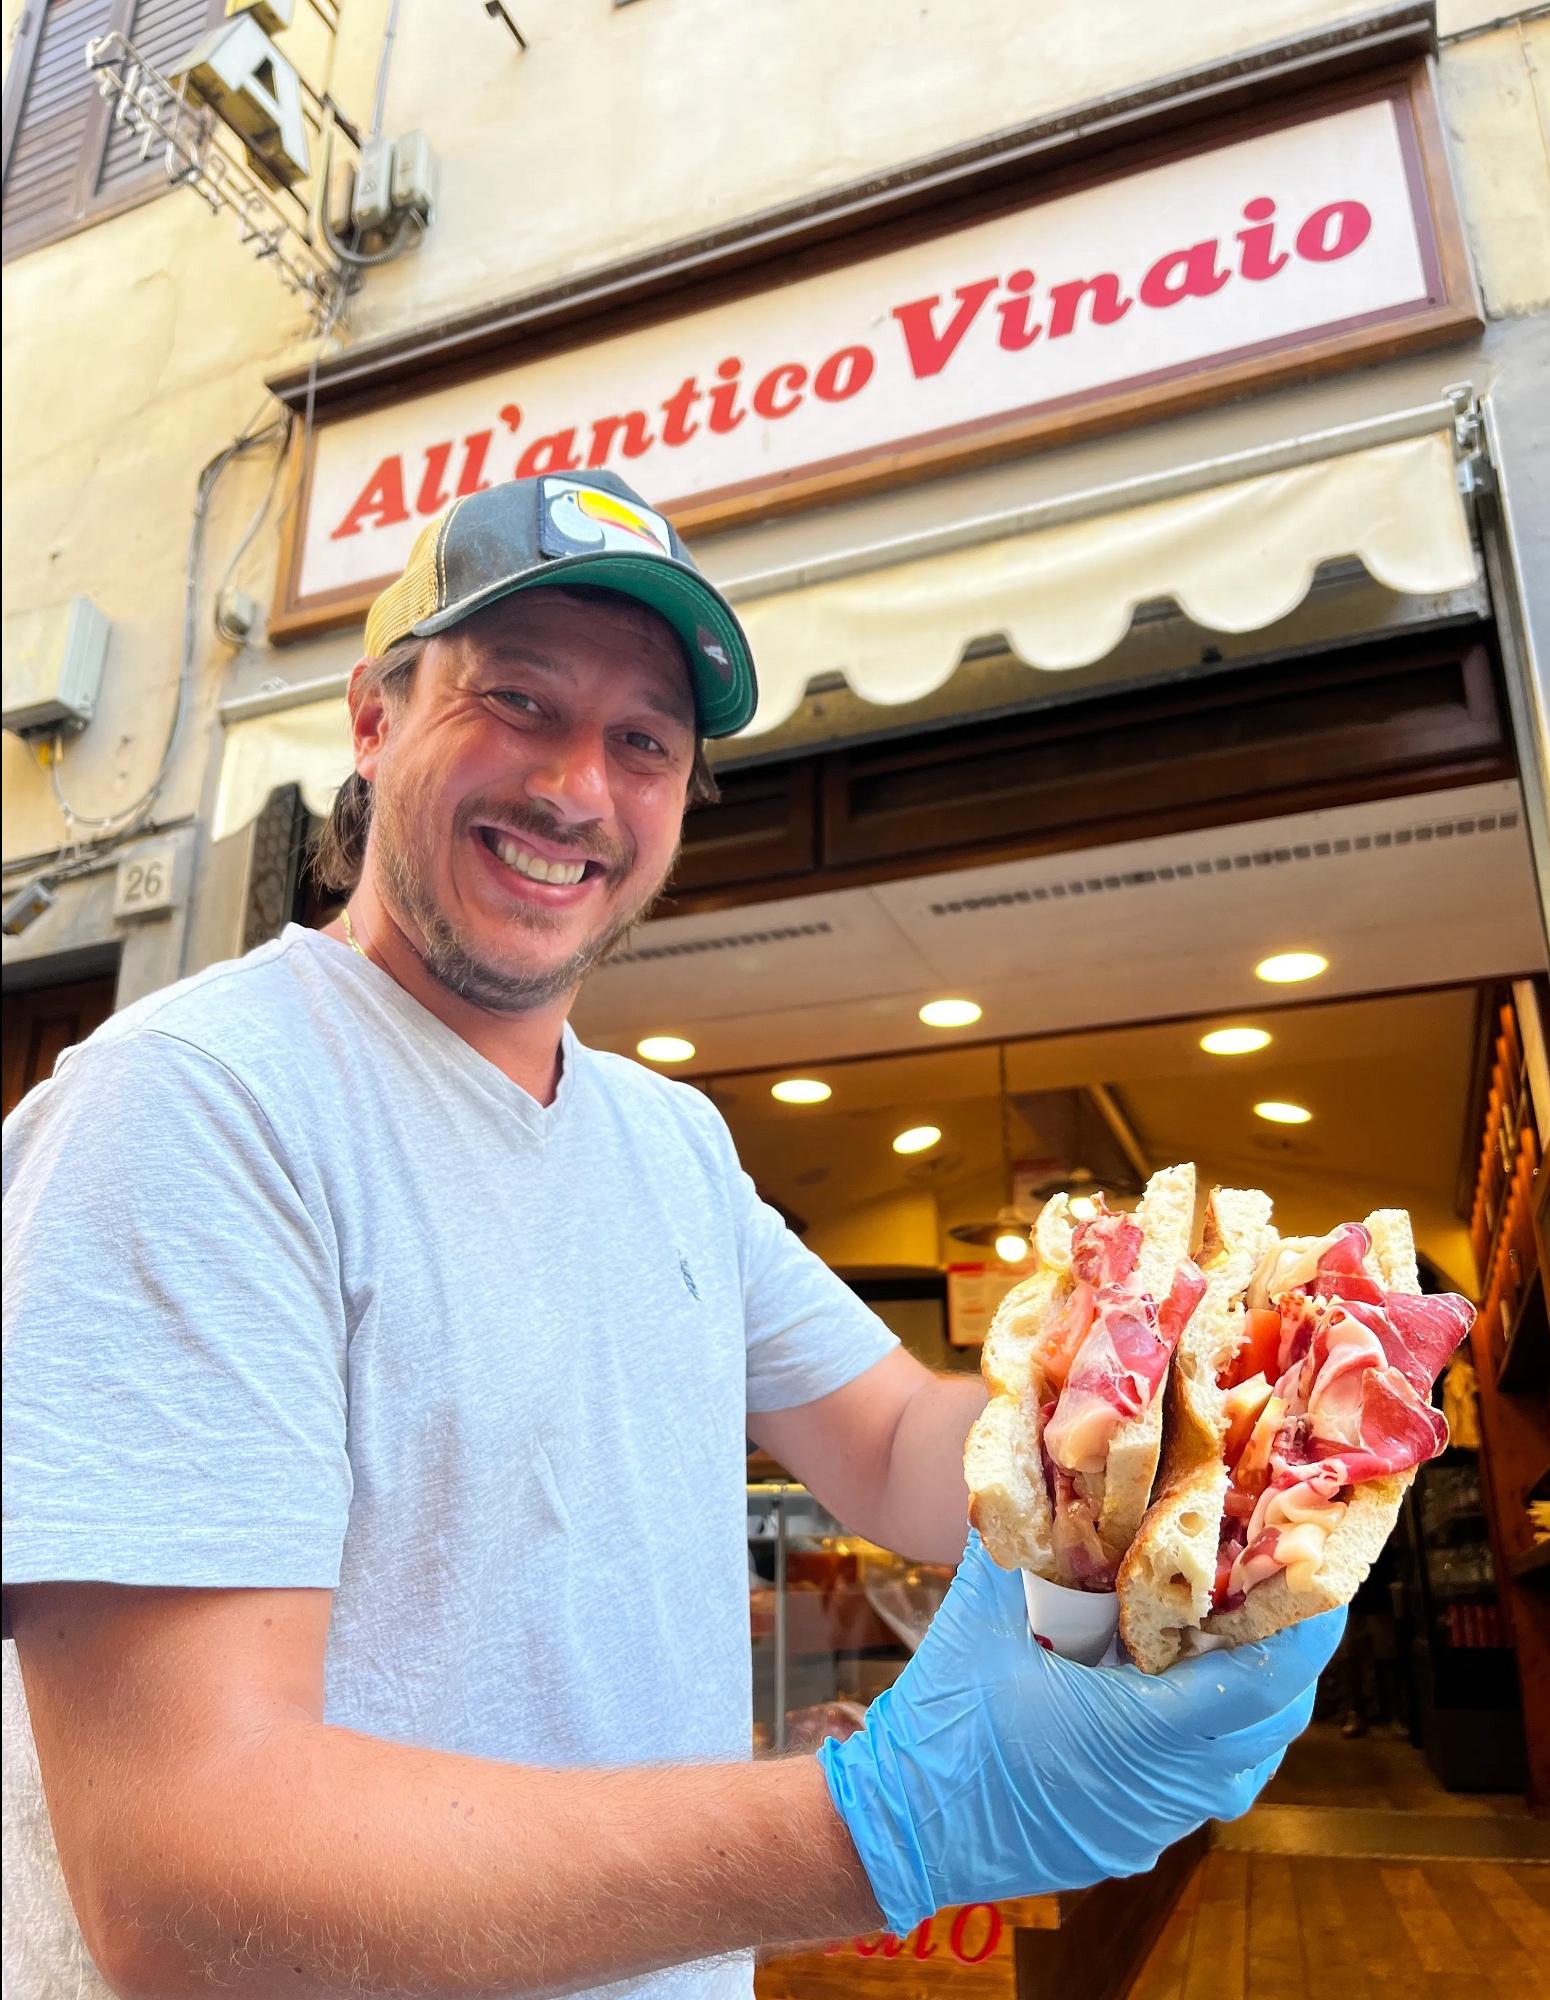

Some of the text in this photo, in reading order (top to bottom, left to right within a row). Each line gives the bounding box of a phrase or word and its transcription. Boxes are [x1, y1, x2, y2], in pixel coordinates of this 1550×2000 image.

[331, 197, 1372, 541] All'antico Vinaio
[124, 861, 163, 902] 26
